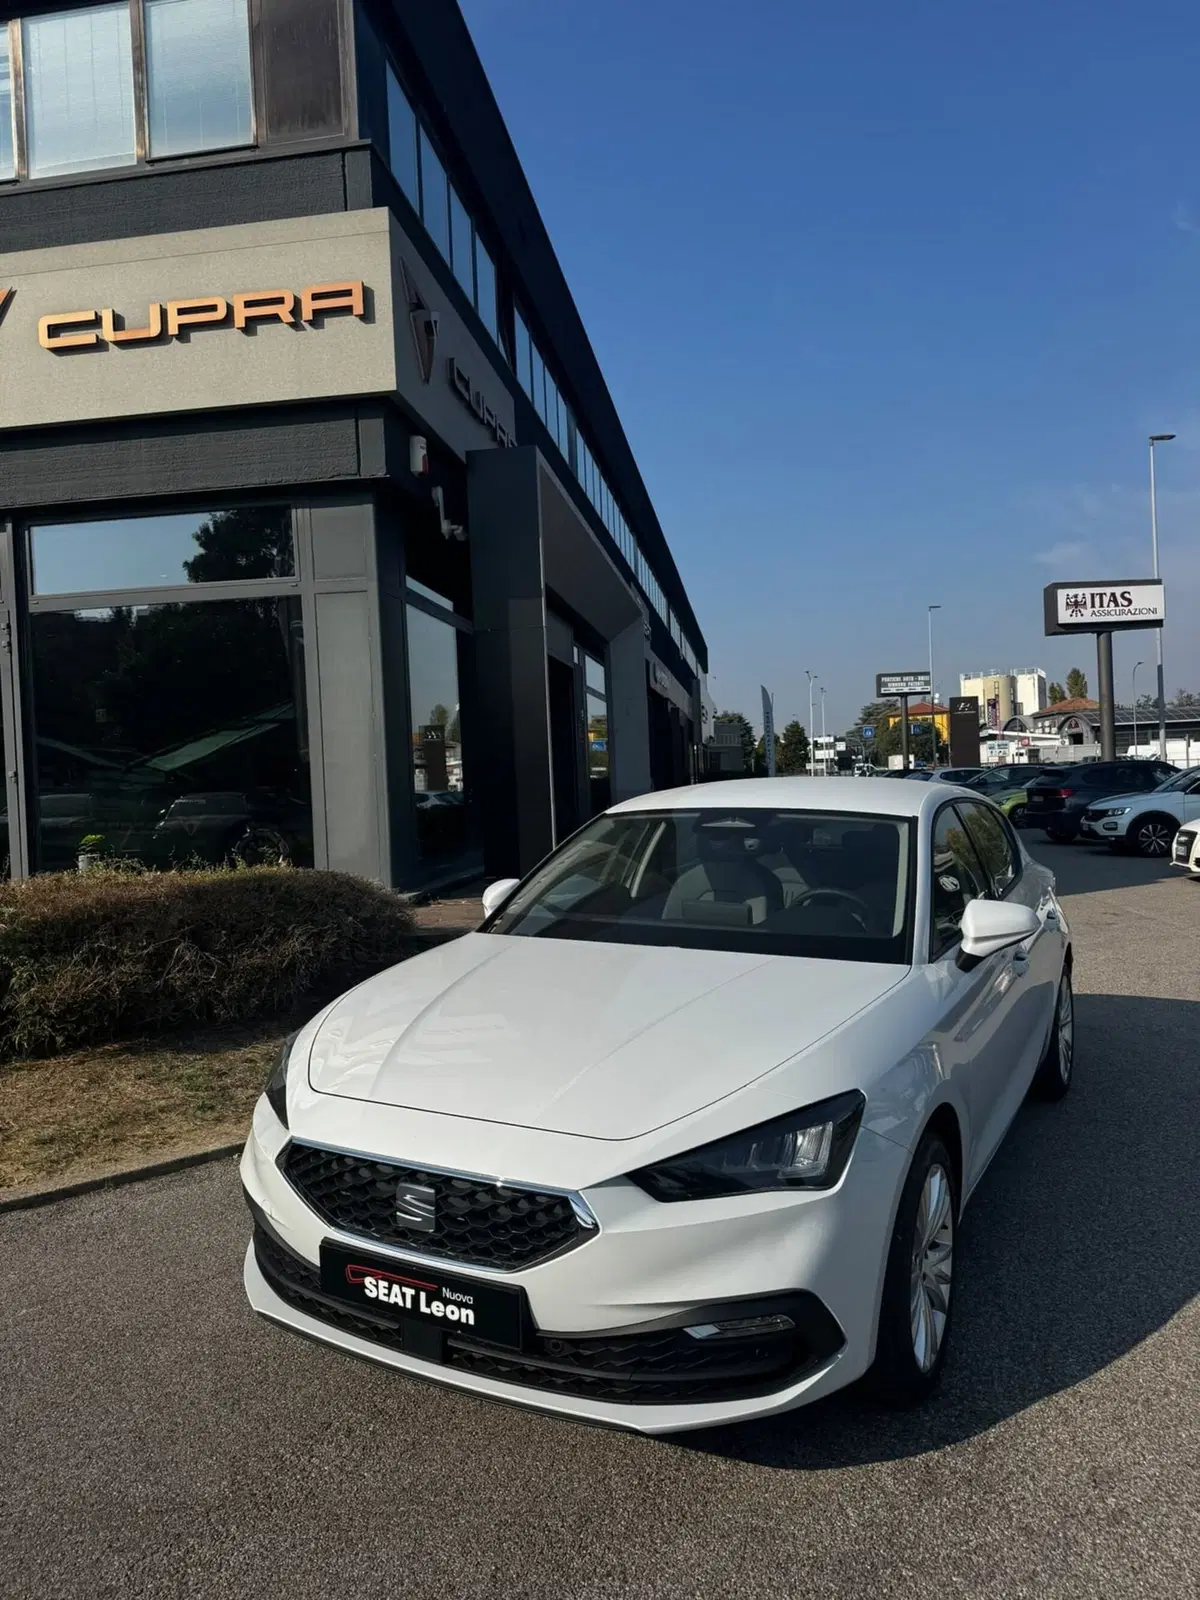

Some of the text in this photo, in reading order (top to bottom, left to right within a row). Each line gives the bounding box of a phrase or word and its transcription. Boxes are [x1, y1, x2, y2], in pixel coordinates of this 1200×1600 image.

[38, 280, 366, 352] CUPRA
[1090, 591, 1133, 609] ITAS
[1090, 607, 1158, 618] ASSICURAZIONI
[364, 1276, 475, 1325] SEAT Leon
[442, 1287, 473, 1304] Nuova
